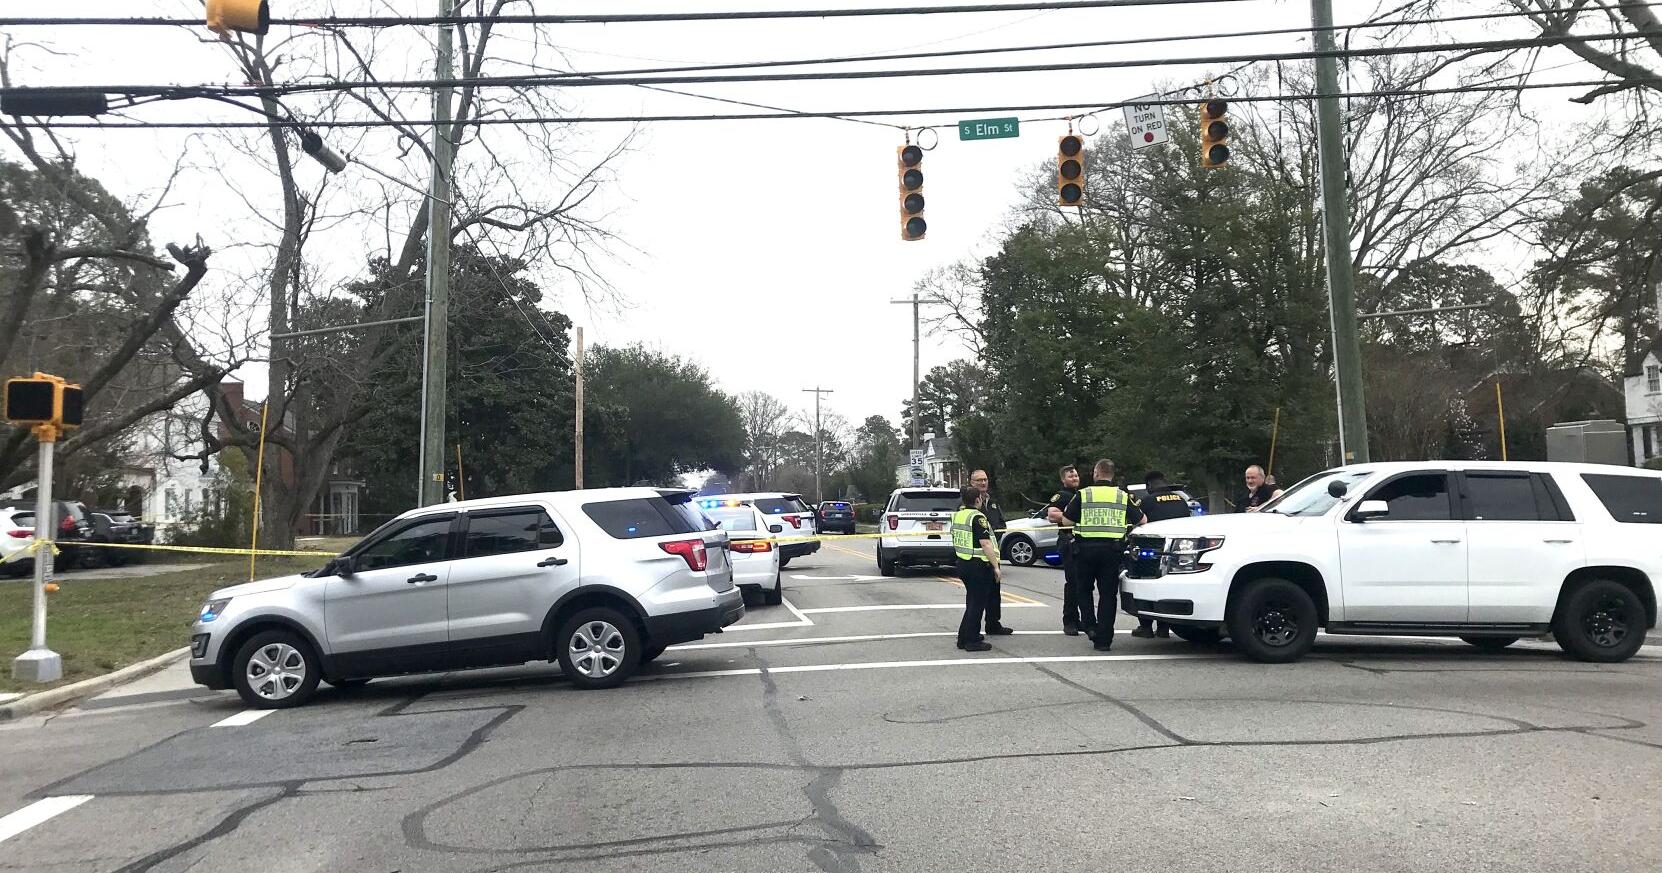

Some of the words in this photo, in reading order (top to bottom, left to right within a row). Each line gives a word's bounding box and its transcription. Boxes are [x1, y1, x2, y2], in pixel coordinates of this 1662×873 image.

[1134, 103, 1150, 112] NO
[1133, 112, 1156, 123] TURN
[964, 126, 971, 135] S
[976, 123, 999, 136] Elm
[1004, 123, 1013, 132] St
[1131, 125, 1143, 135] ON
[1146, 120, 1162, 131] RED
[911, 457, 923, 465] 35
[1156, 494, 1181, 502] POLICE
[1084, 516, 1123, 526] POLICE
